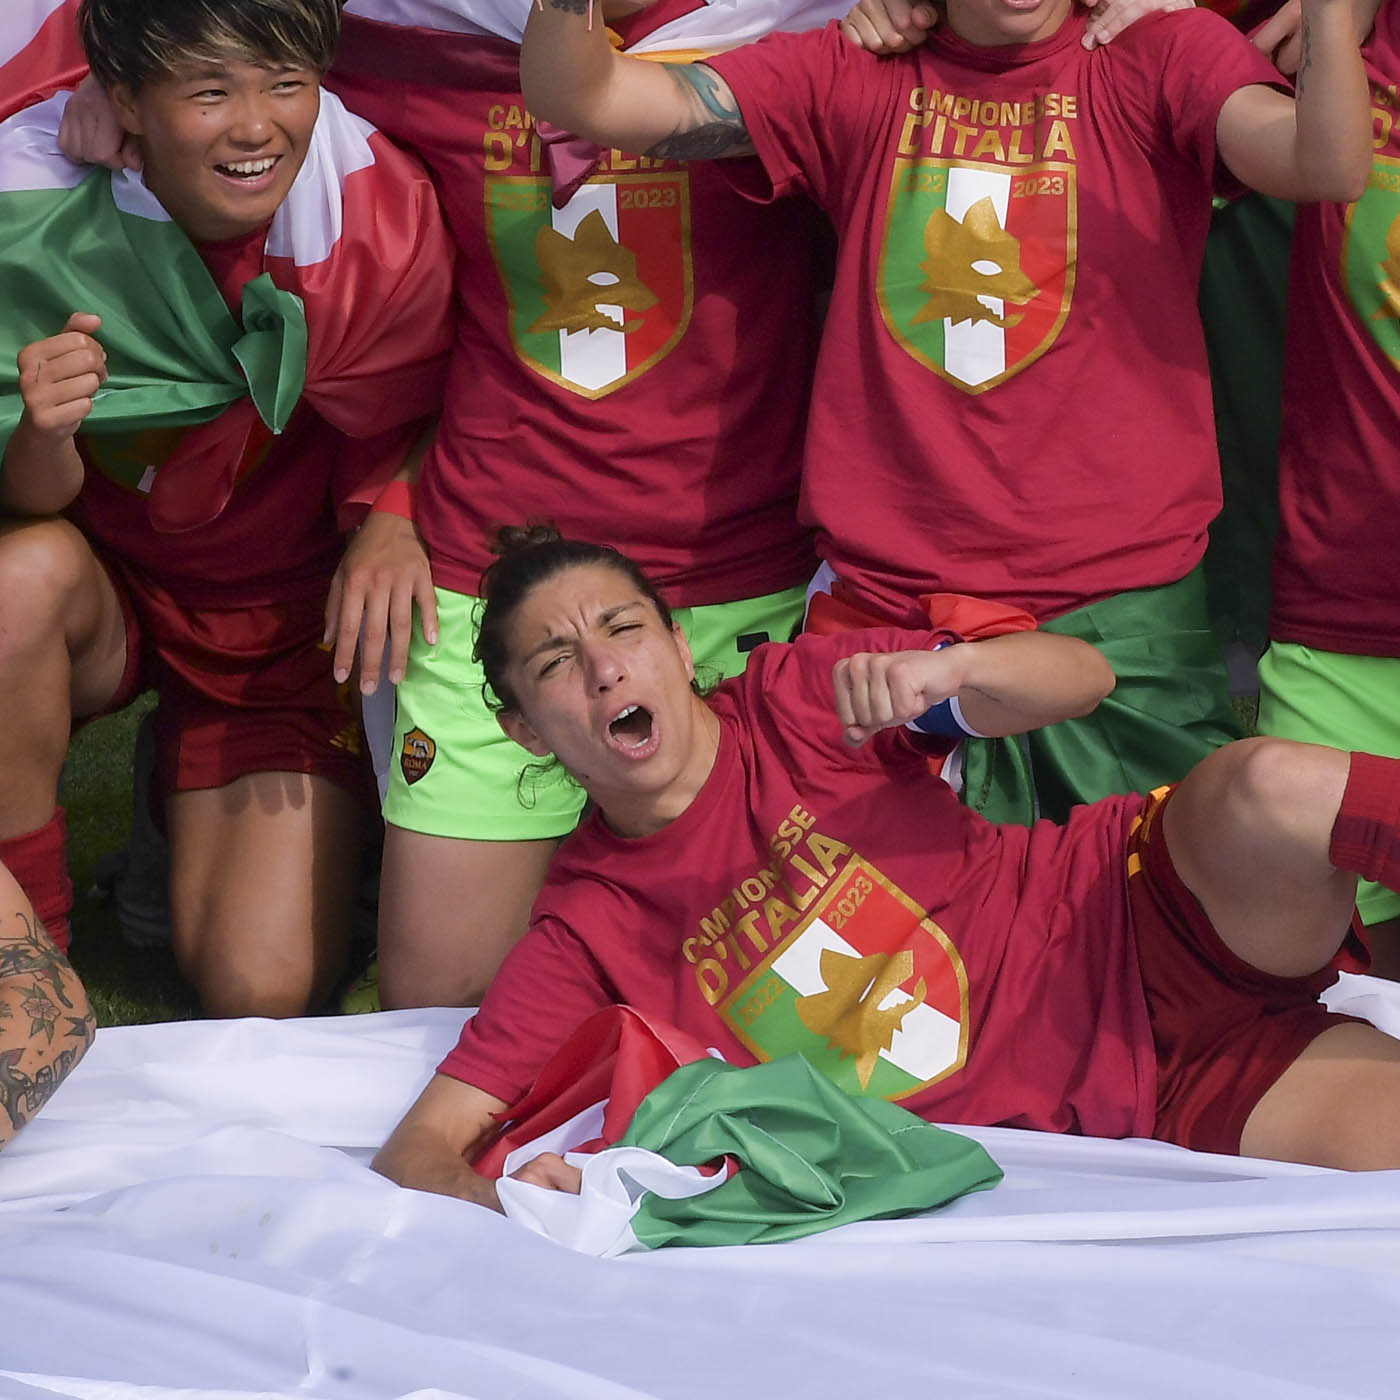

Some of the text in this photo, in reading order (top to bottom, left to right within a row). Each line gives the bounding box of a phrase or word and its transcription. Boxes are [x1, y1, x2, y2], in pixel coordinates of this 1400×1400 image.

[620, 187, 678, 209] 2023
[1012, 175, 1065, 198] 2023
[695, 831, 853, 1007] D'ITALIA
[827, 874, 874, 931] 2023
